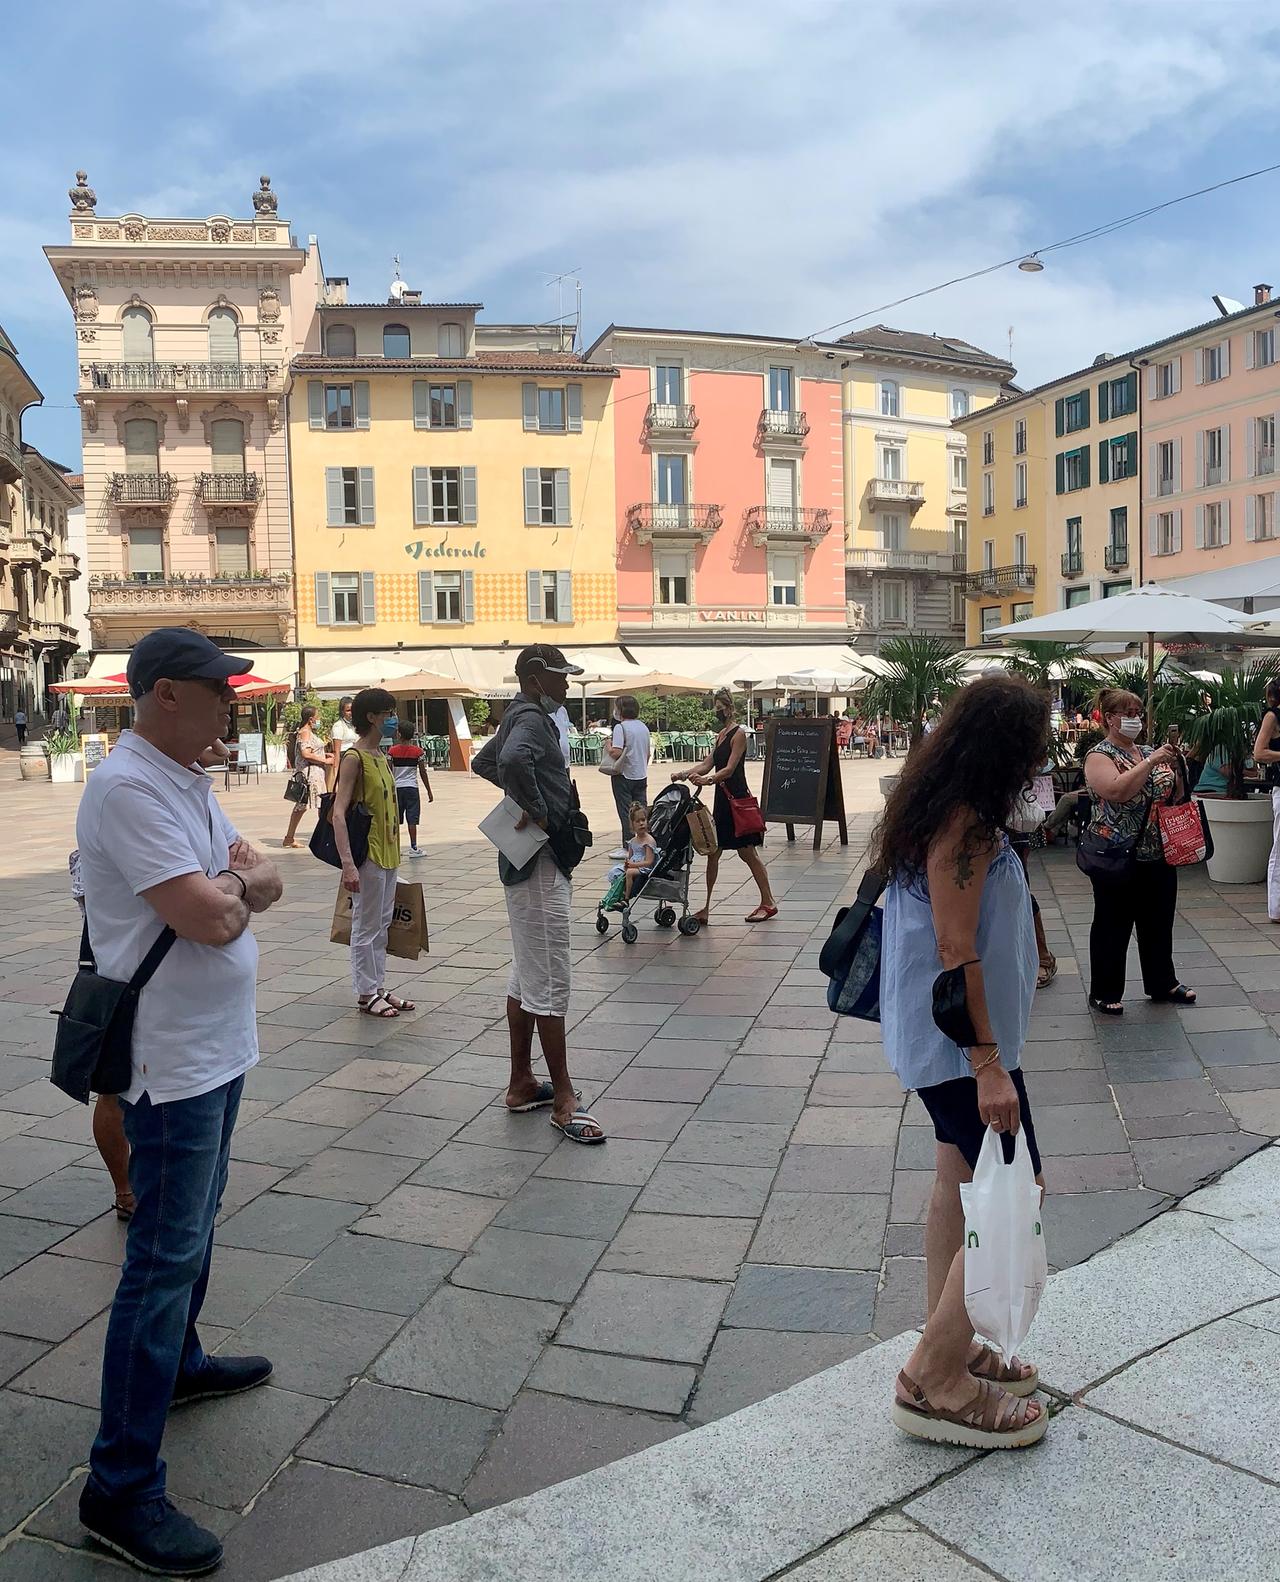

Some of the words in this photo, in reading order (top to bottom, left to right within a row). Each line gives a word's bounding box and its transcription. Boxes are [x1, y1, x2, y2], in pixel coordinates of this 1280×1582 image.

[405, 540, 486, 560] Federale
[702, 610, 767, 621] VANINI
[1165, 810, 1190, 824] friends
